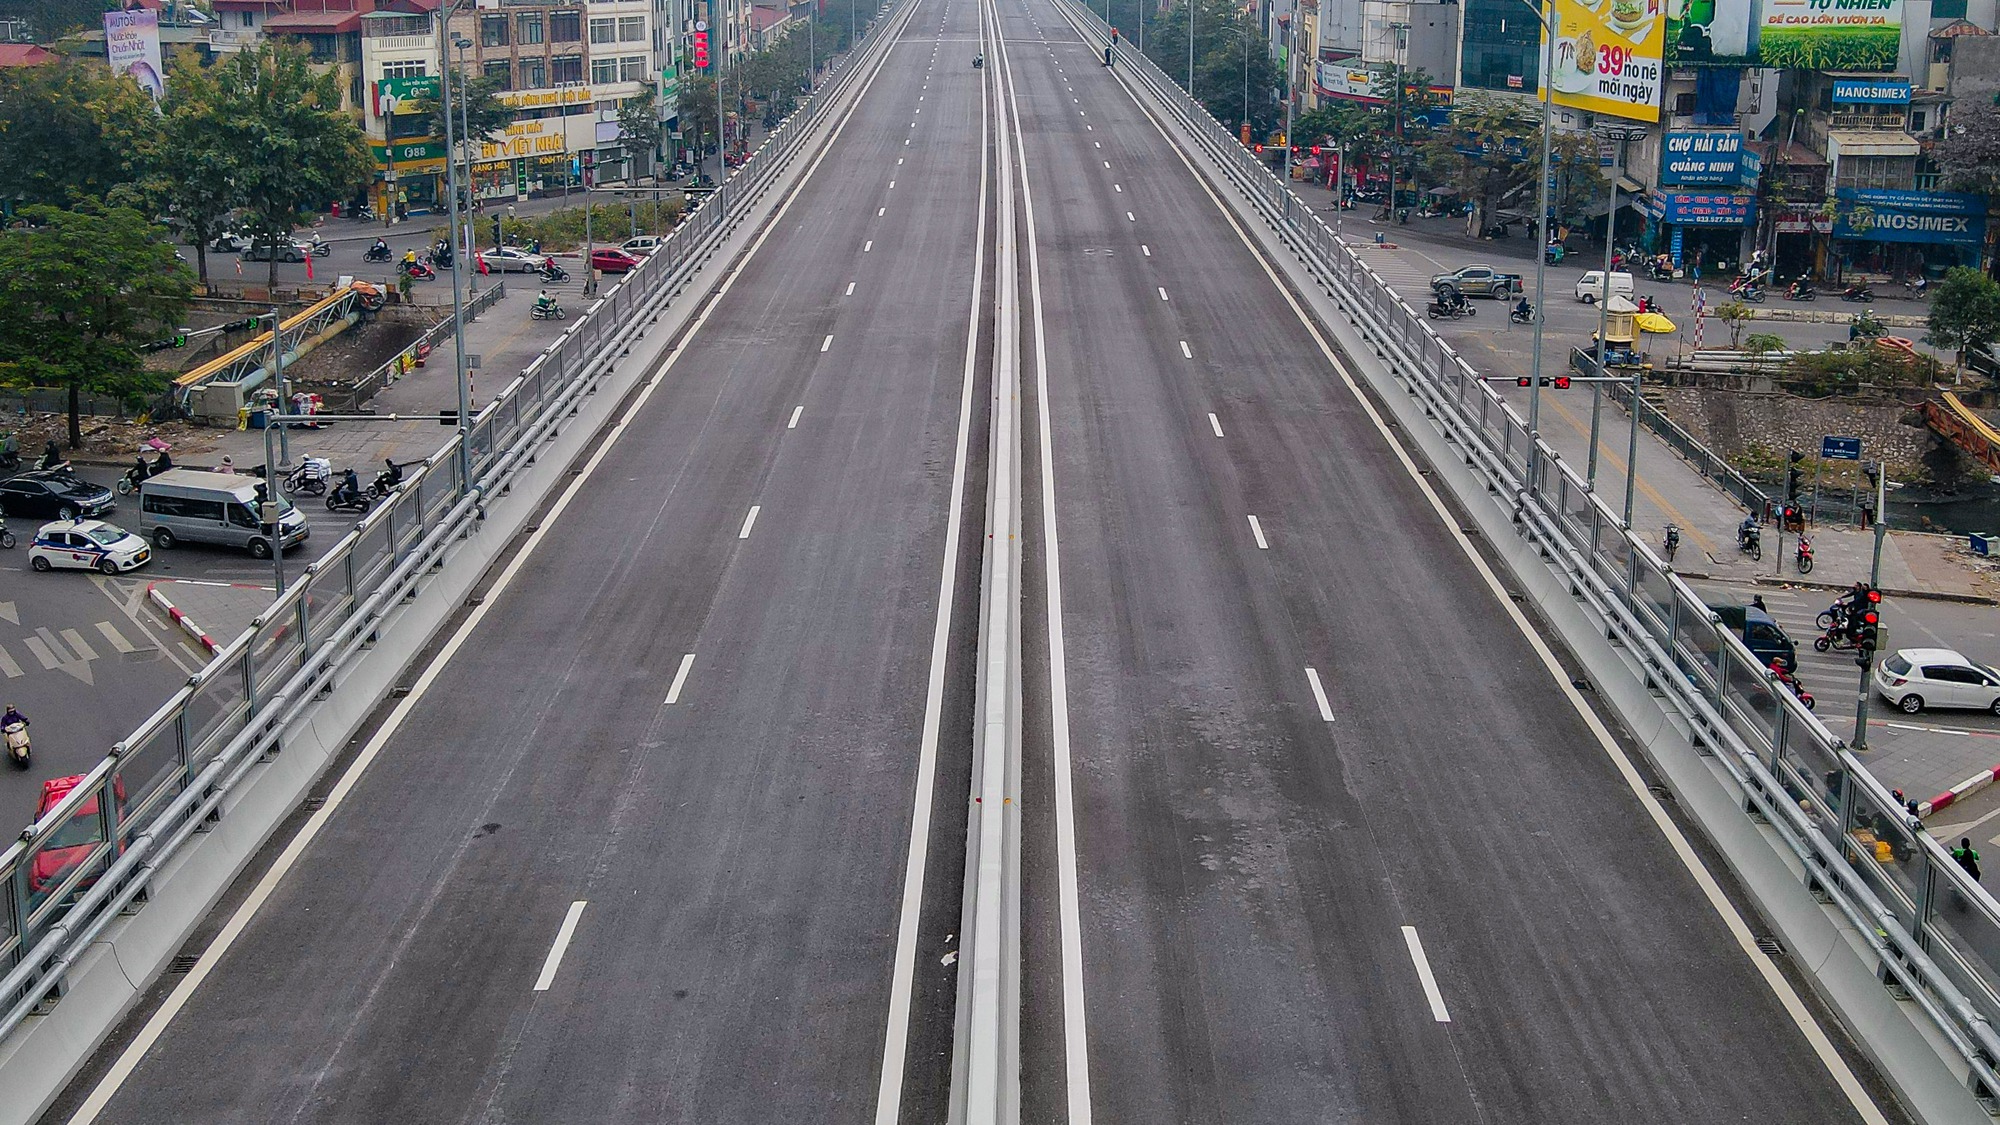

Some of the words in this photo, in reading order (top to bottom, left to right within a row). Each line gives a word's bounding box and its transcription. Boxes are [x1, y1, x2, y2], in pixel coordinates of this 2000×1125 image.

[1768, 13, 1783, 24] ĐỂ
[1786, 15, 1809, 24] CAO
[1870, 16, 1885, 24] XA
[1624, 62, 1639, 79] no
[1641, 62, 1657, 80] nê
[1599, 77, 1621, 96] mỗi
[1622, 81, 1653, 105] ngày
[1836, 85, 1907, 99] HANOSIMEX
[481, 142, 498, 158] BV
[501, 135, 532, 158] VIỆT
[1668, 136, 1693, 155] CHỢ
[1694, 133, 1714, 152] HẢI
[1716, 133, 1739, 152] SẢN
[1670, 157, 1705, 173] QUẢNG
[1708, 161, 1735, 173] NINH
